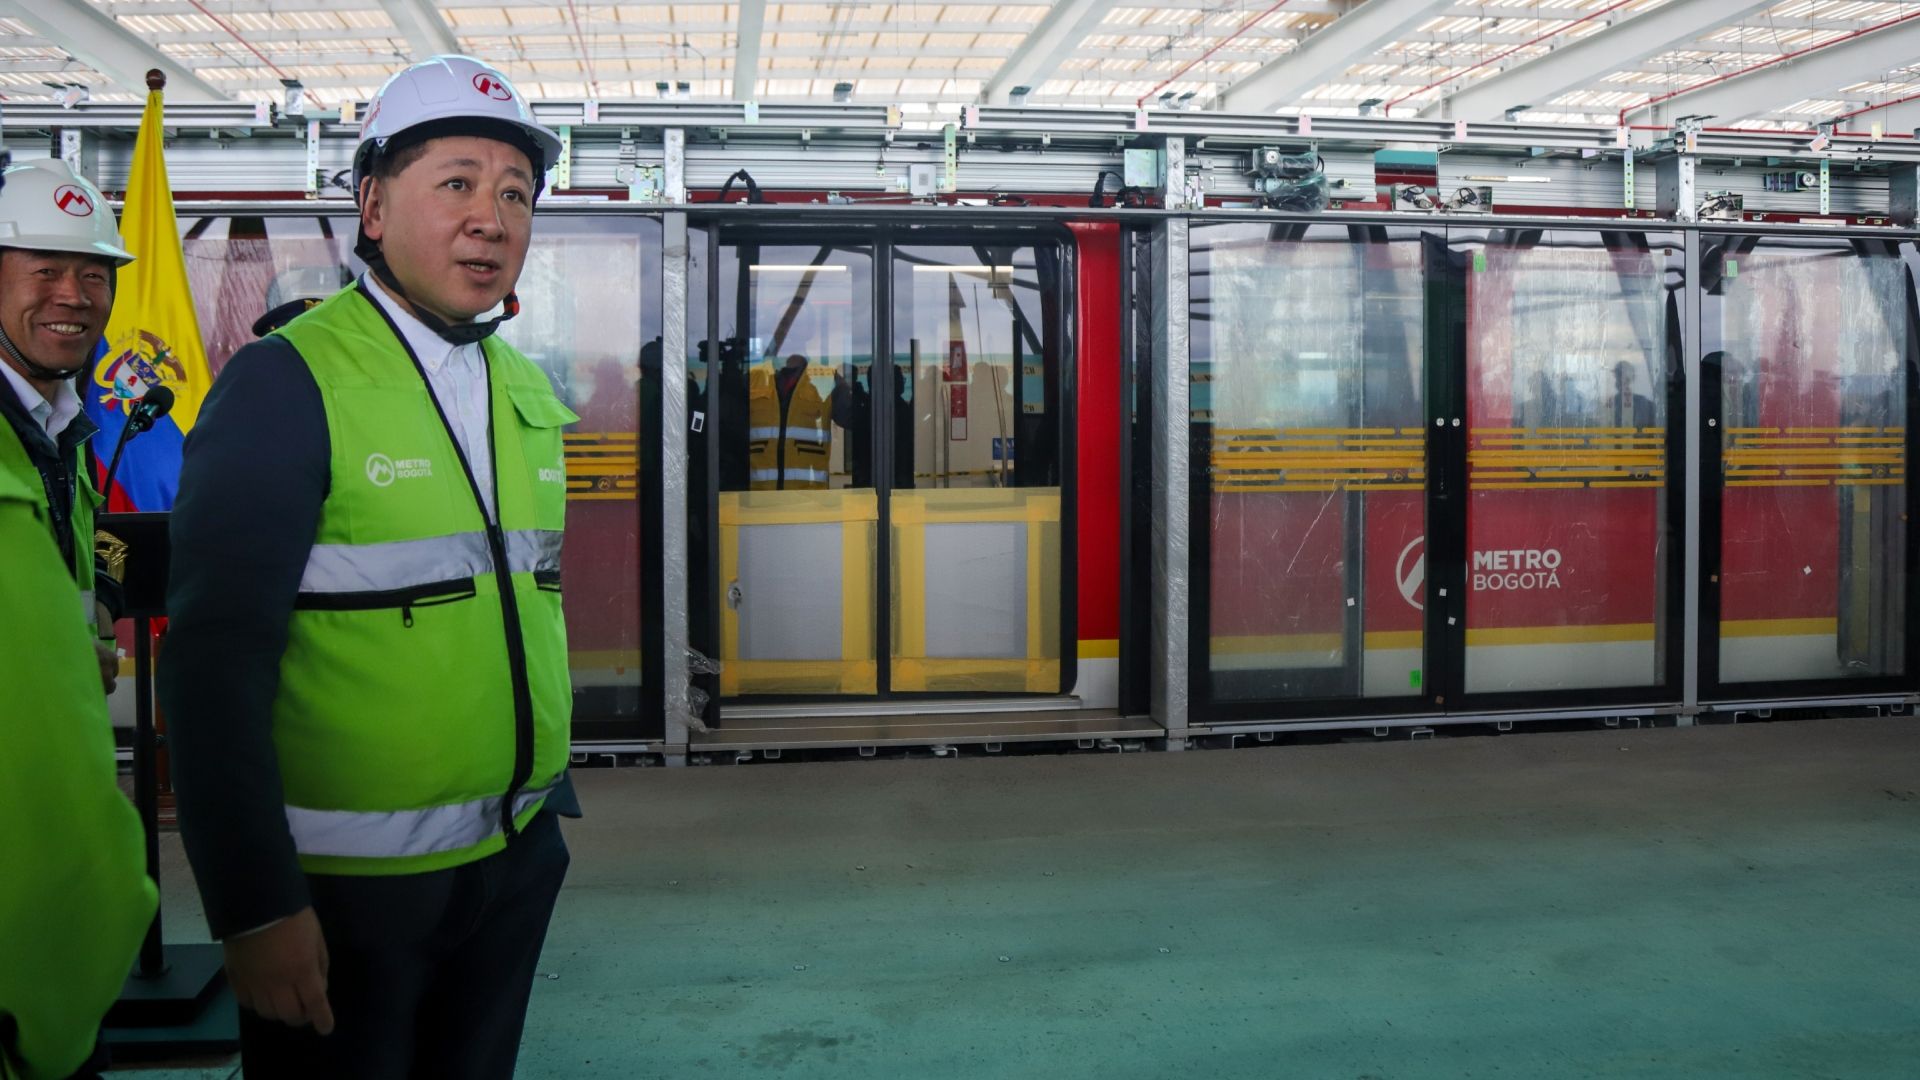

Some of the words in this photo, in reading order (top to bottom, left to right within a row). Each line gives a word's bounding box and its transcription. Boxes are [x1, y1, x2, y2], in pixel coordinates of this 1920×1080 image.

[395, 458, 432, 469] METRO
[1473, 549, 1562, 571] METRO
[1473, 569, 1561, 591] BOGOTÁ
